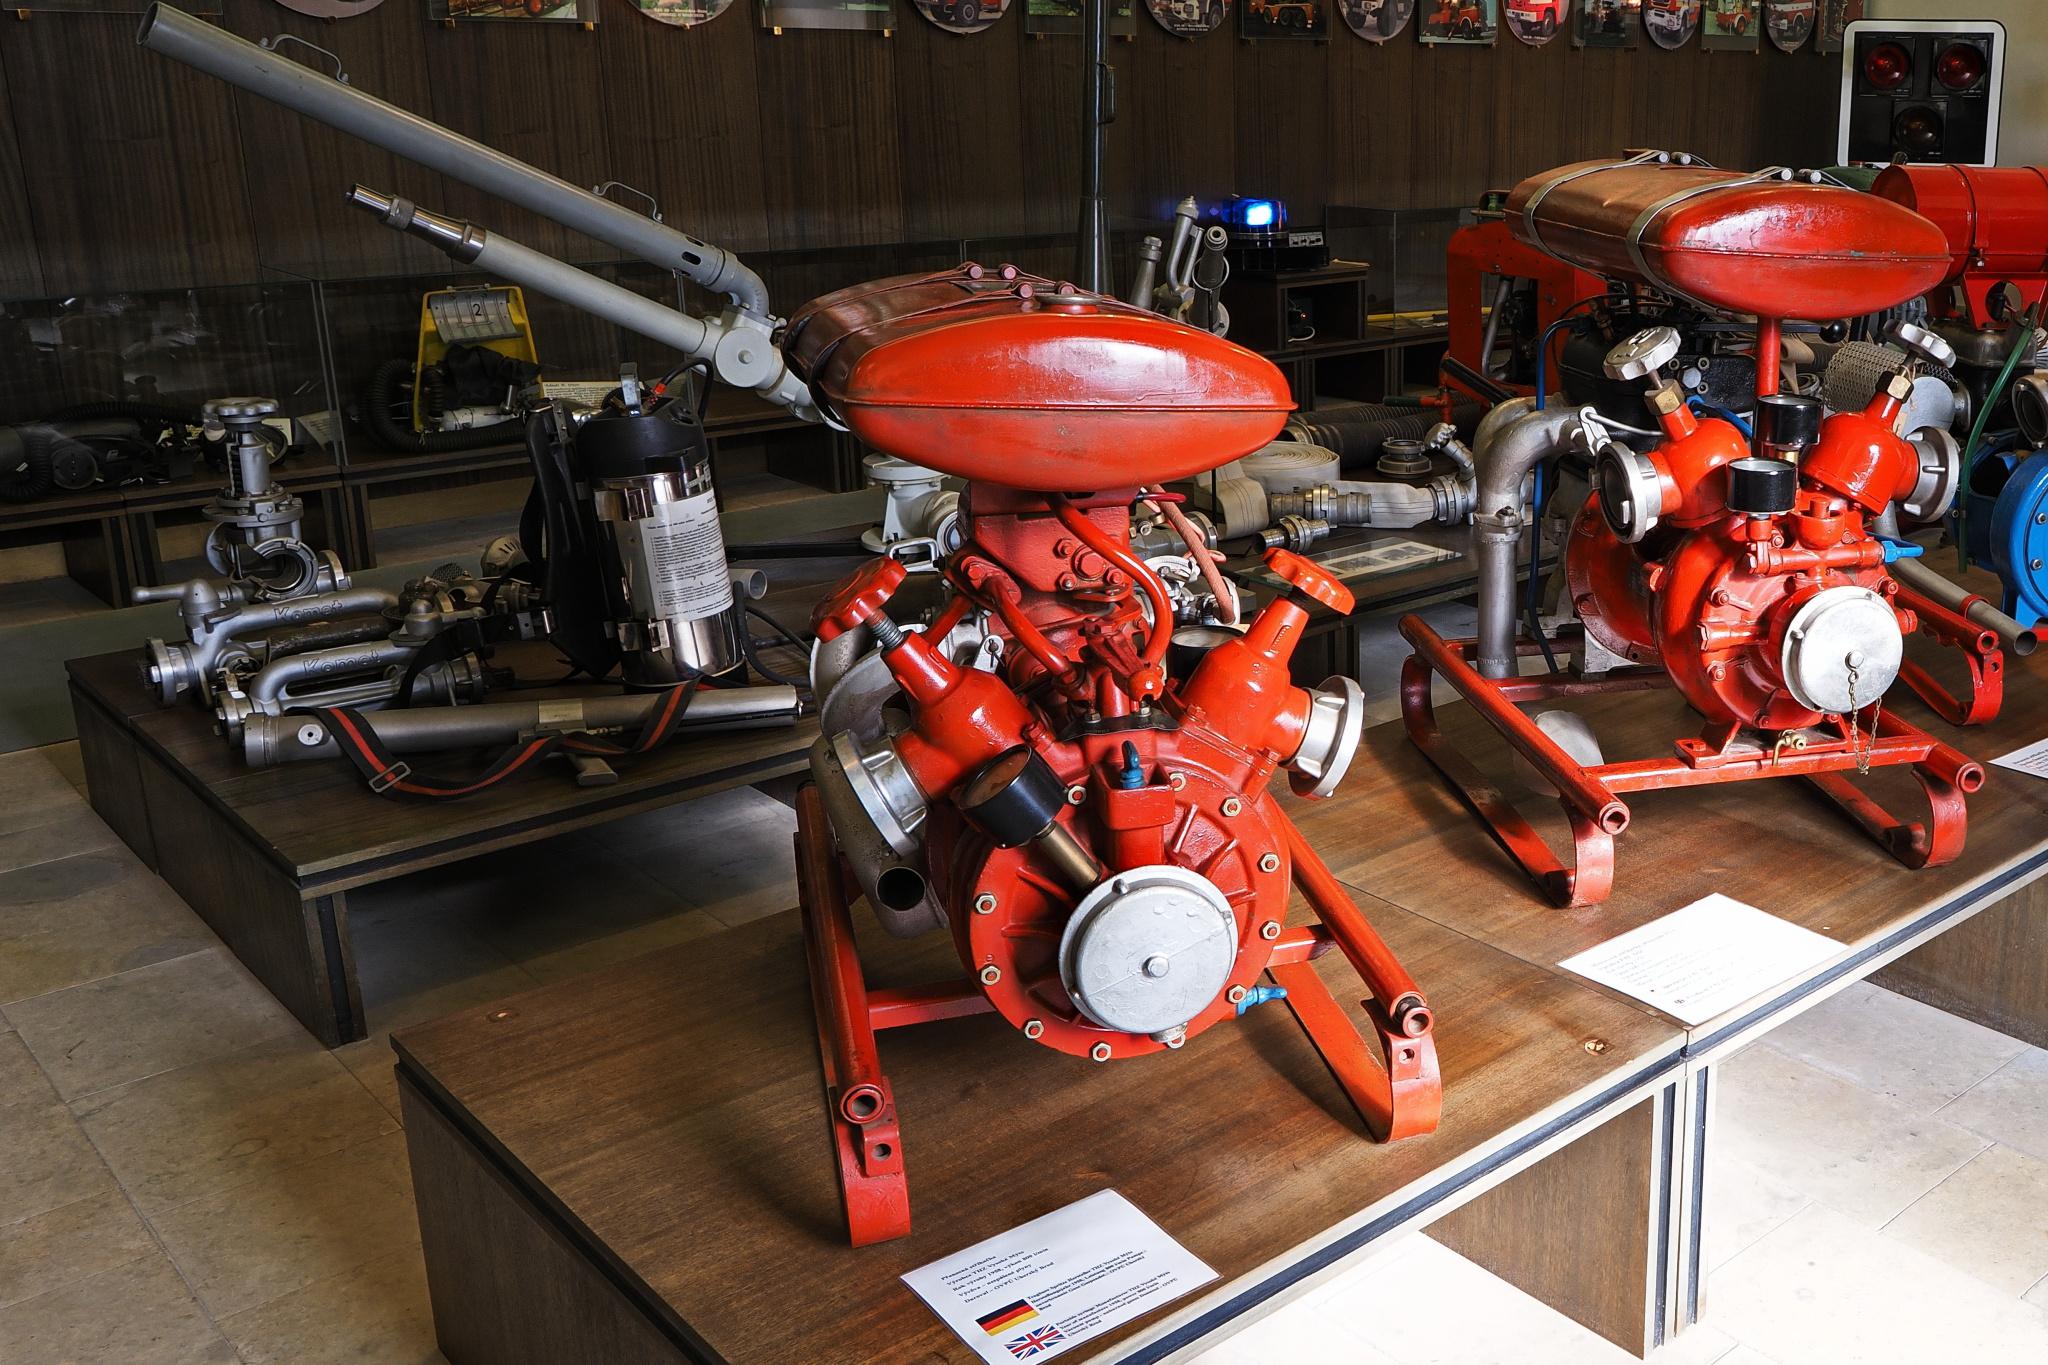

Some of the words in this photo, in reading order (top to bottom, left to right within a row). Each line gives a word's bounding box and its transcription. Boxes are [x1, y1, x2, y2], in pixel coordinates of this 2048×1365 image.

[472, 303, 482, 317] 2
[274, 600, 343, 621] Komet
[303, 650, 383, 677] Komet
